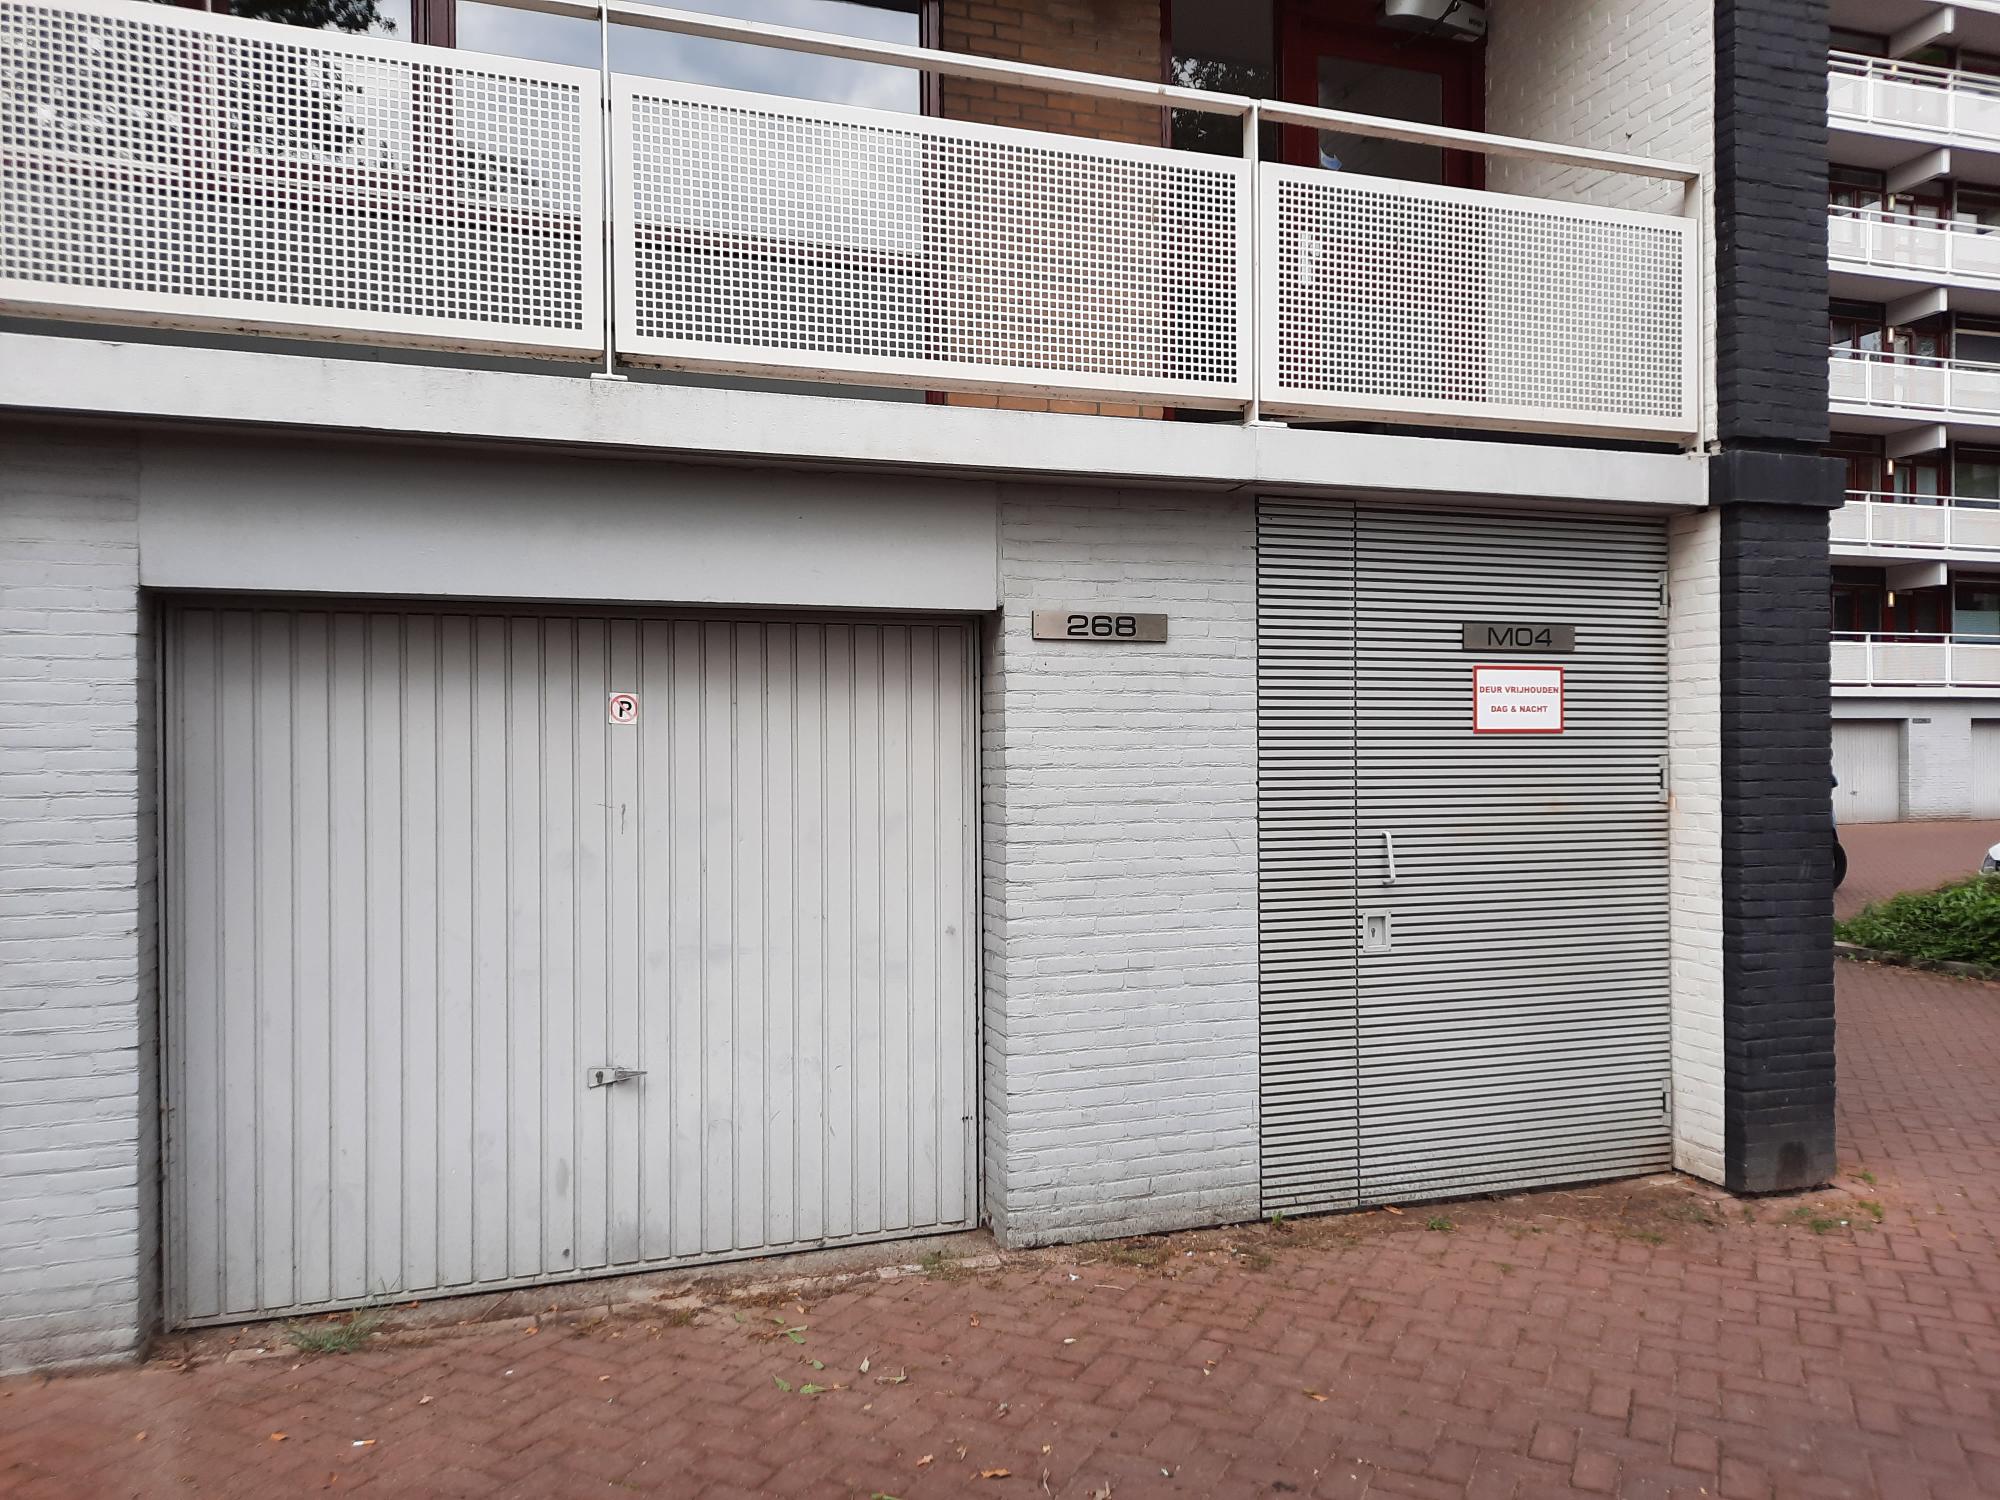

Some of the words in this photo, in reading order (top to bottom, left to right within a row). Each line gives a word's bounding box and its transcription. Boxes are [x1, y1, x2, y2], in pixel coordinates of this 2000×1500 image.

[1067, 615, 1137, 637] 268
[1488, 627, 1552, 647] M04
[1479, 686, 1502, 694] DEUR
[1505, 686, 1559, 694] VRIJHOUDEN
[619, 700, 632, 717] P
[1491, 705, 1508, 713] DAG
[1510, 705, 1517, 713] &
[1519, 705, 1548, 713] NACHT
